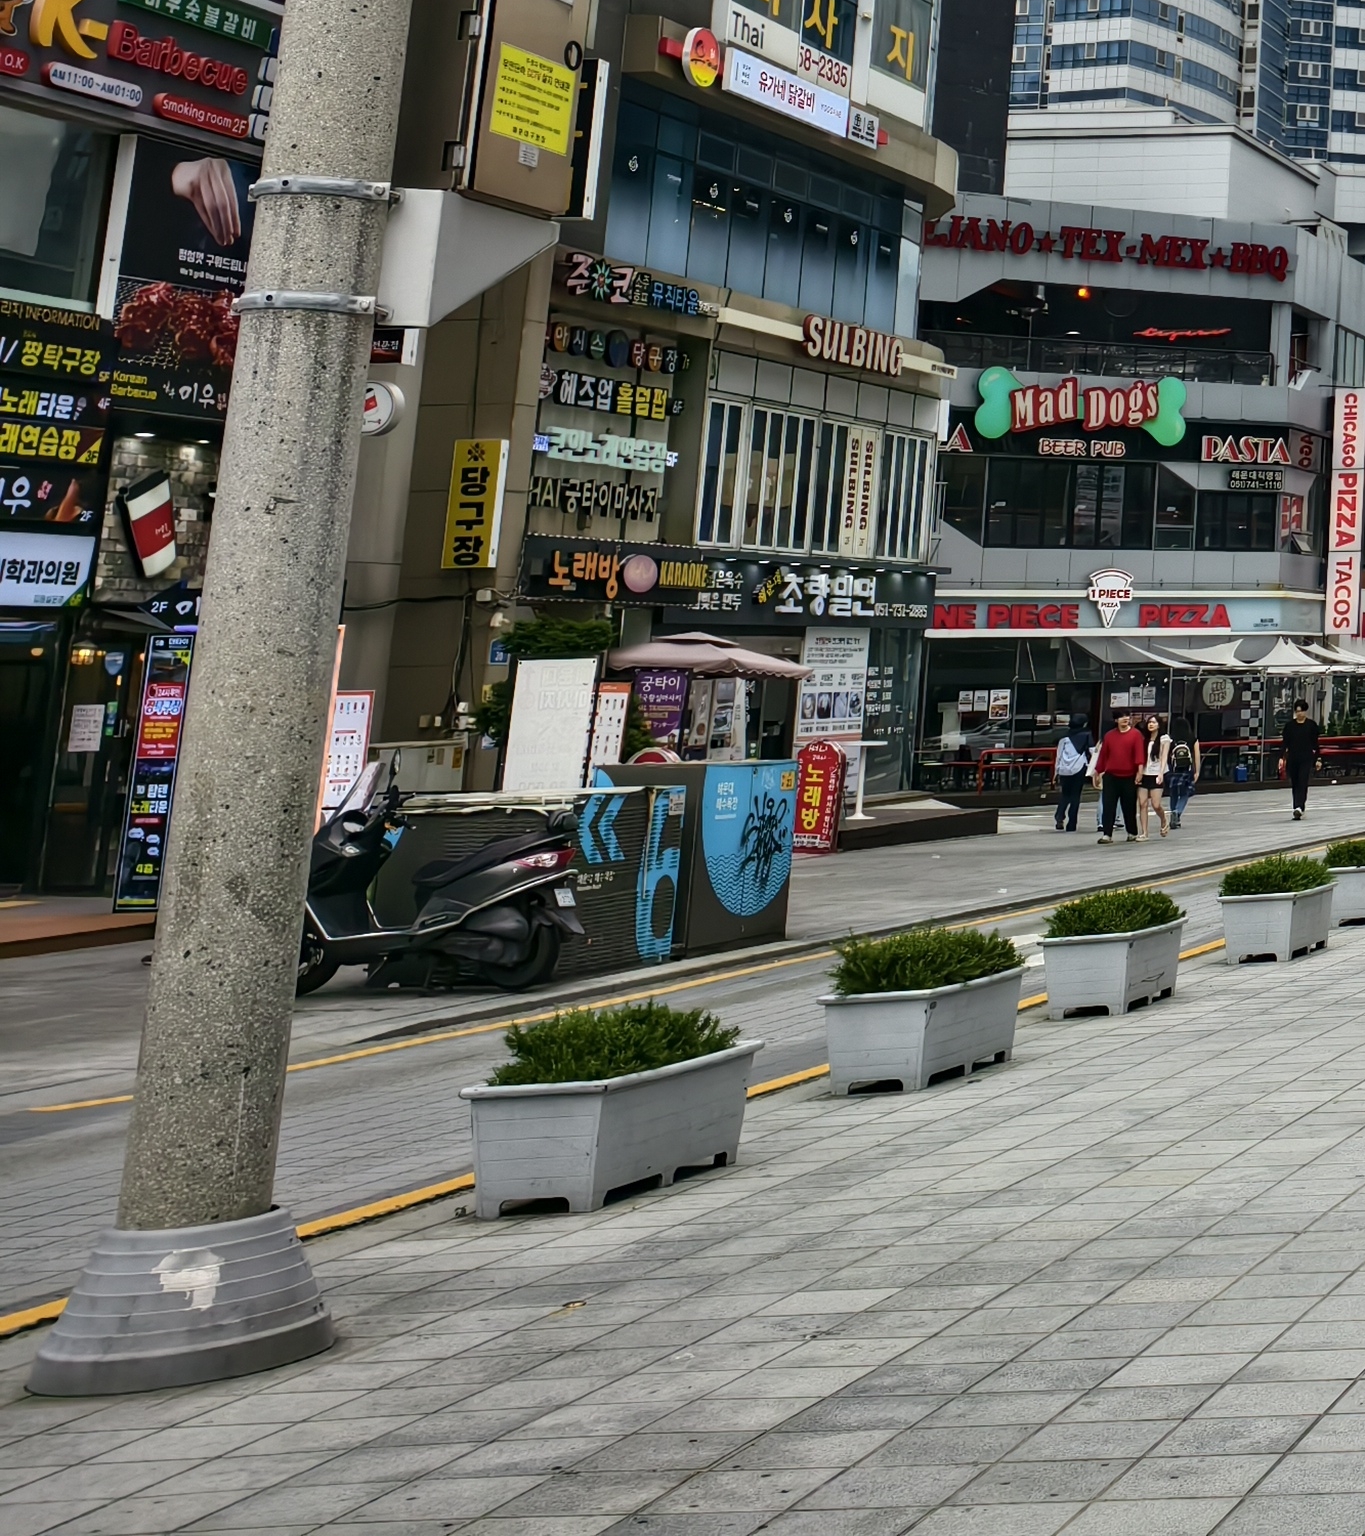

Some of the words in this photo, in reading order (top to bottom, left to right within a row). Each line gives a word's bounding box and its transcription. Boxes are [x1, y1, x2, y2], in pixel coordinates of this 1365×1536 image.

[732, 10, 765, 50] Thai
[758, 71, 787, 102] 유가네
[788, 83, 816, 114] 닭갈비
[162, 97, 206, 122] smoking
[205, 110, 232, 129] room
[232, 117, 248, 134] 2F
[925, 214, 1034, 255] EJANO
[1230, 242, 1290, 282] BBQ
[25, 305, 101, 331] INFORMATION
[651, 280, 699, 315] 뮤직타운
[632, 341, 678, 374] 당구장
[807, 316, 905, 377] SULBING
[112, 369, 148, 385] Korean
[559, 370, 614, 412] 헤즈업
[616, 381, 669, 421] 홀덤펍
[1013, 380, 1076, 429] Mad
[1038, 436, 1086, 457] BEER
[1090, 438, 1126, 458] PUB
[1201, 434, 1292, 465] PASTA
[1341, 391, 1359, 469] CHICAGO
[564, 478, 659, 523] 궁타이마사지
[844, 437, 860, 530] SULBING
[858, 439, 874, 531] SULBING
[79, 510, 94, 522] 2F
[452, 466, 491, 566] 당구장
[1334, 471, 1359, 549] PIZZA
[548, 550, 620, 599] 노래방
[1098, 589, 1132, 600] PIECE
[1332, 556, 1354, 630] TACOS
[150, 601, 169, 614] 2F
[932, 603, 977, 630] NE
[985, 603, 1080, 630] PIECE
[1138, 603, 1232, 629] PIZZA
[640, 675, 681, 693] 궁타이
[801, 763, 824, 831] 노래방
